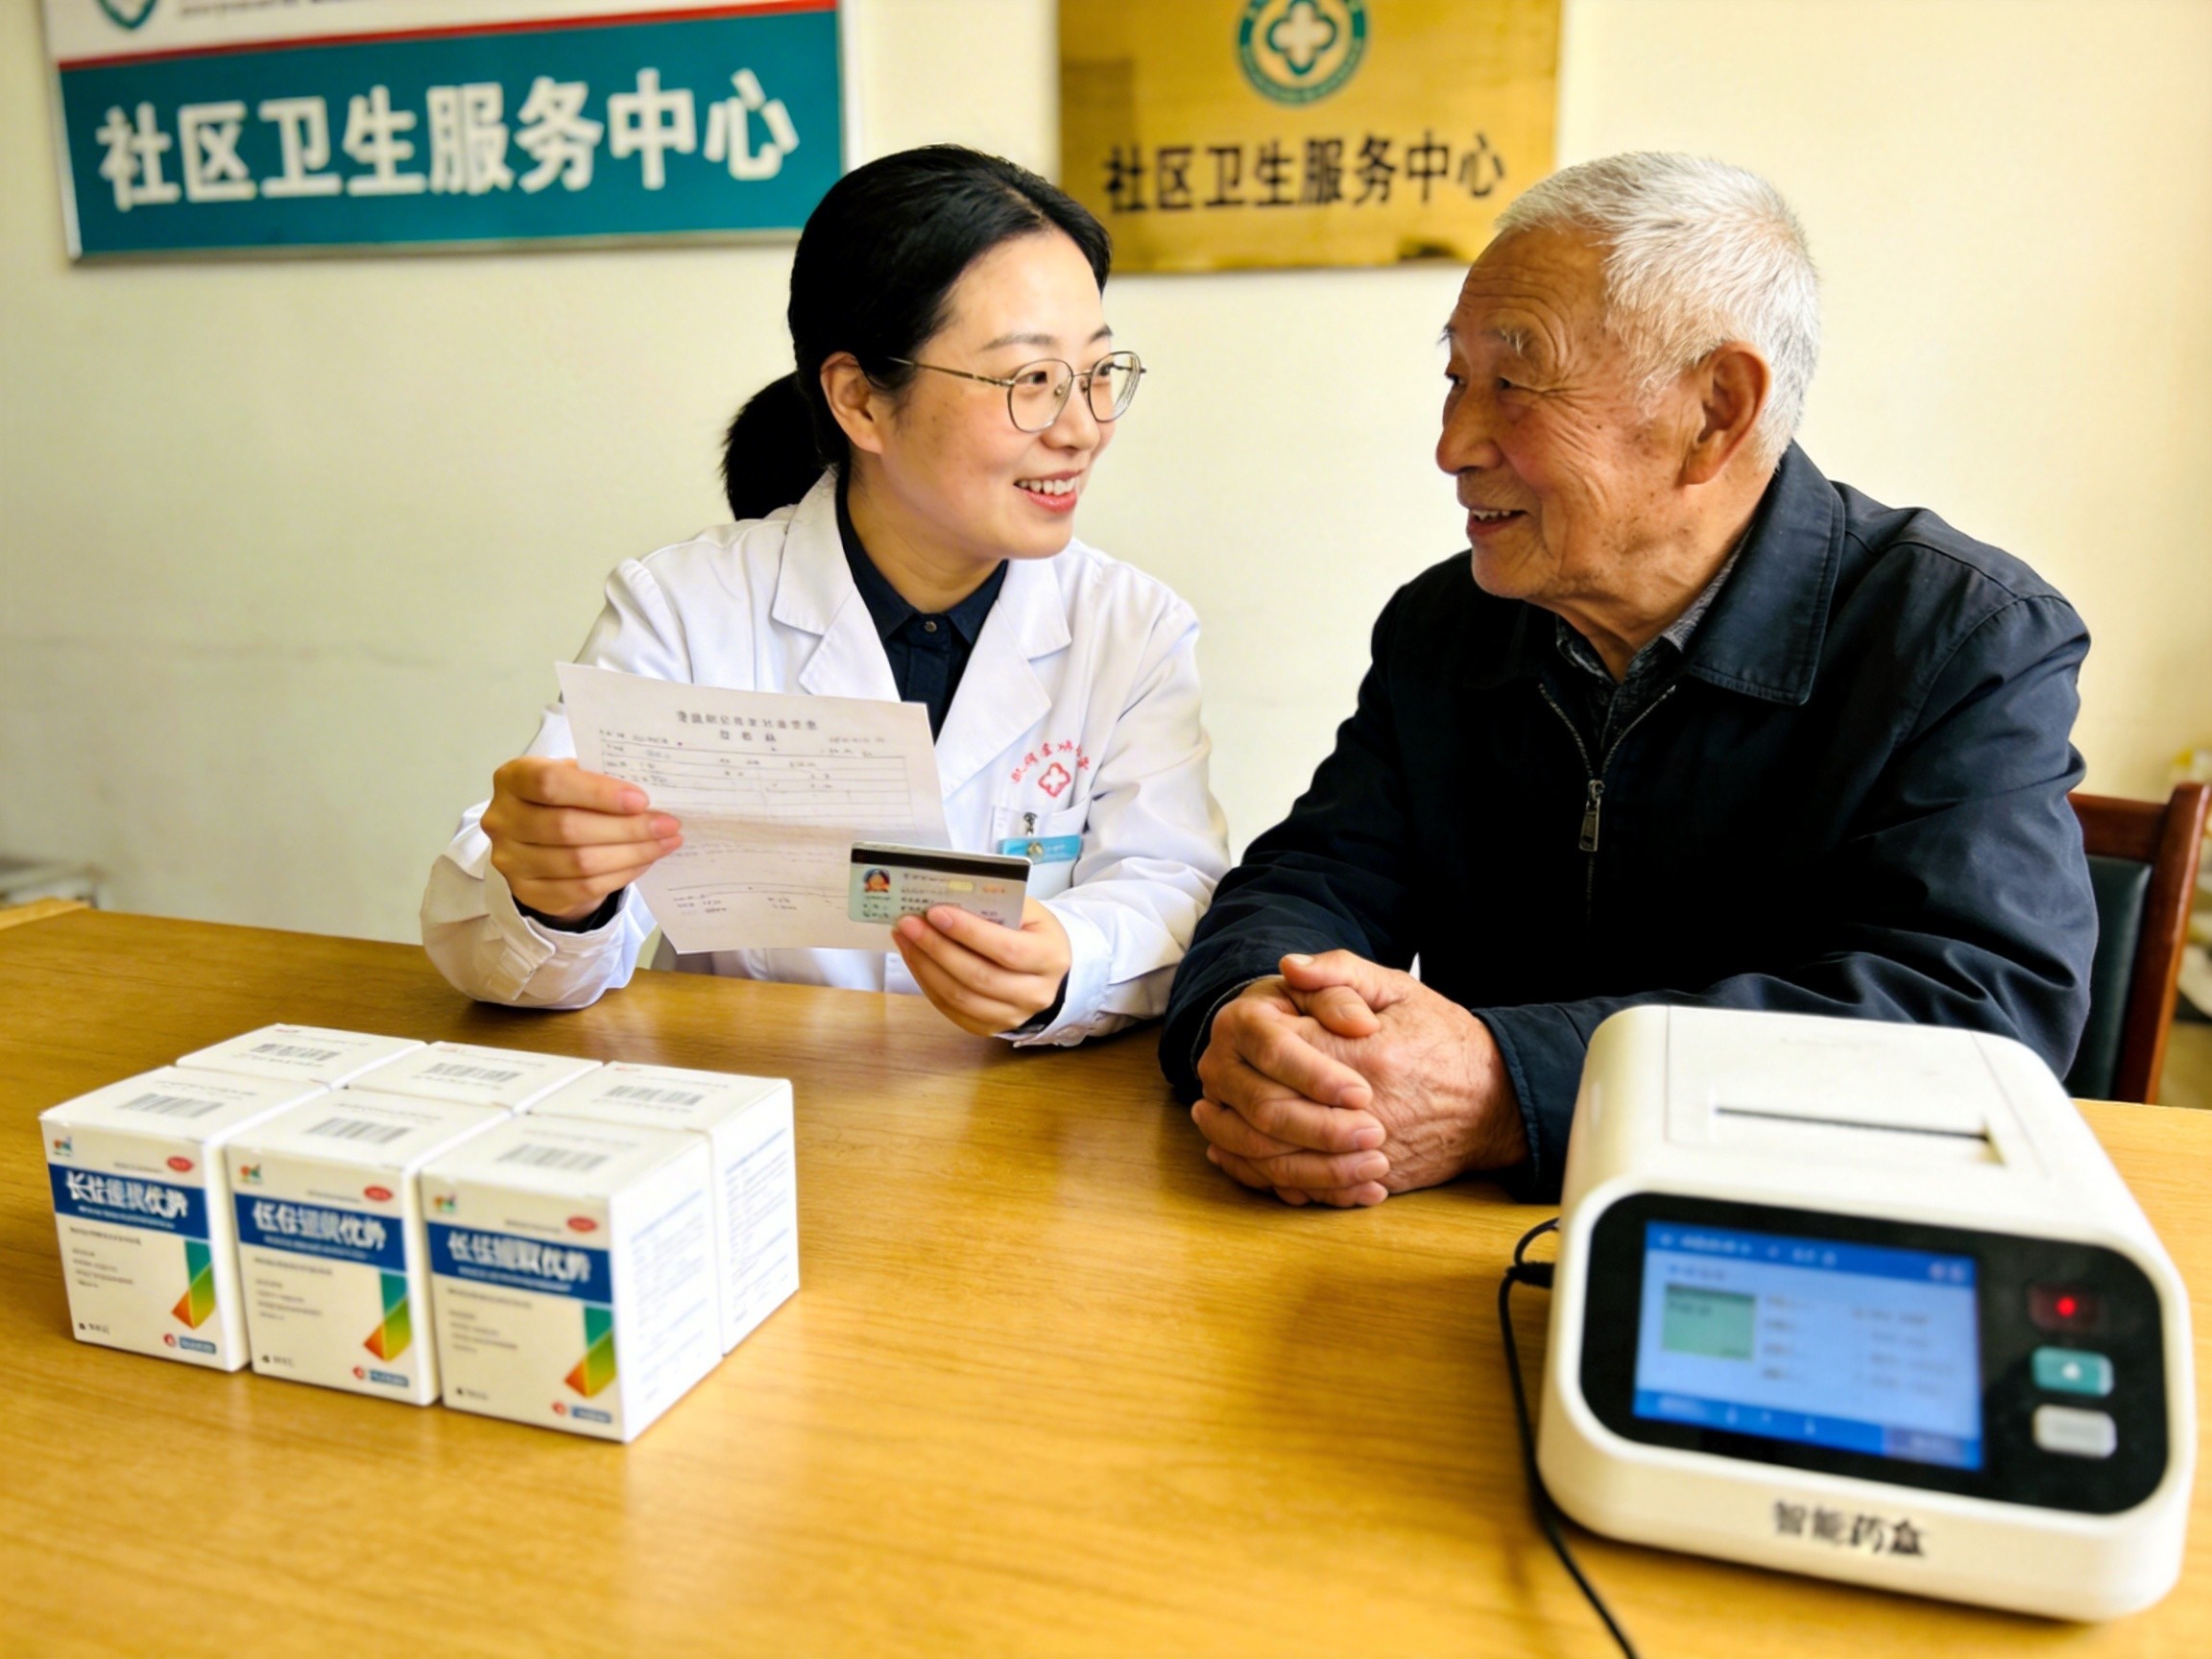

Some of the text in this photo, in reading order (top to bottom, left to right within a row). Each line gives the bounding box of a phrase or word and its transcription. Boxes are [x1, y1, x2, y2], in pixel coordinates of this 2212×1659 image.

[96, 67, 801, 212] 社区卫生服务中心
[1103, 127, 1506, 213] 社区卫生服务中心
[1773, 1500, 1925, 1557] 智能药盒
